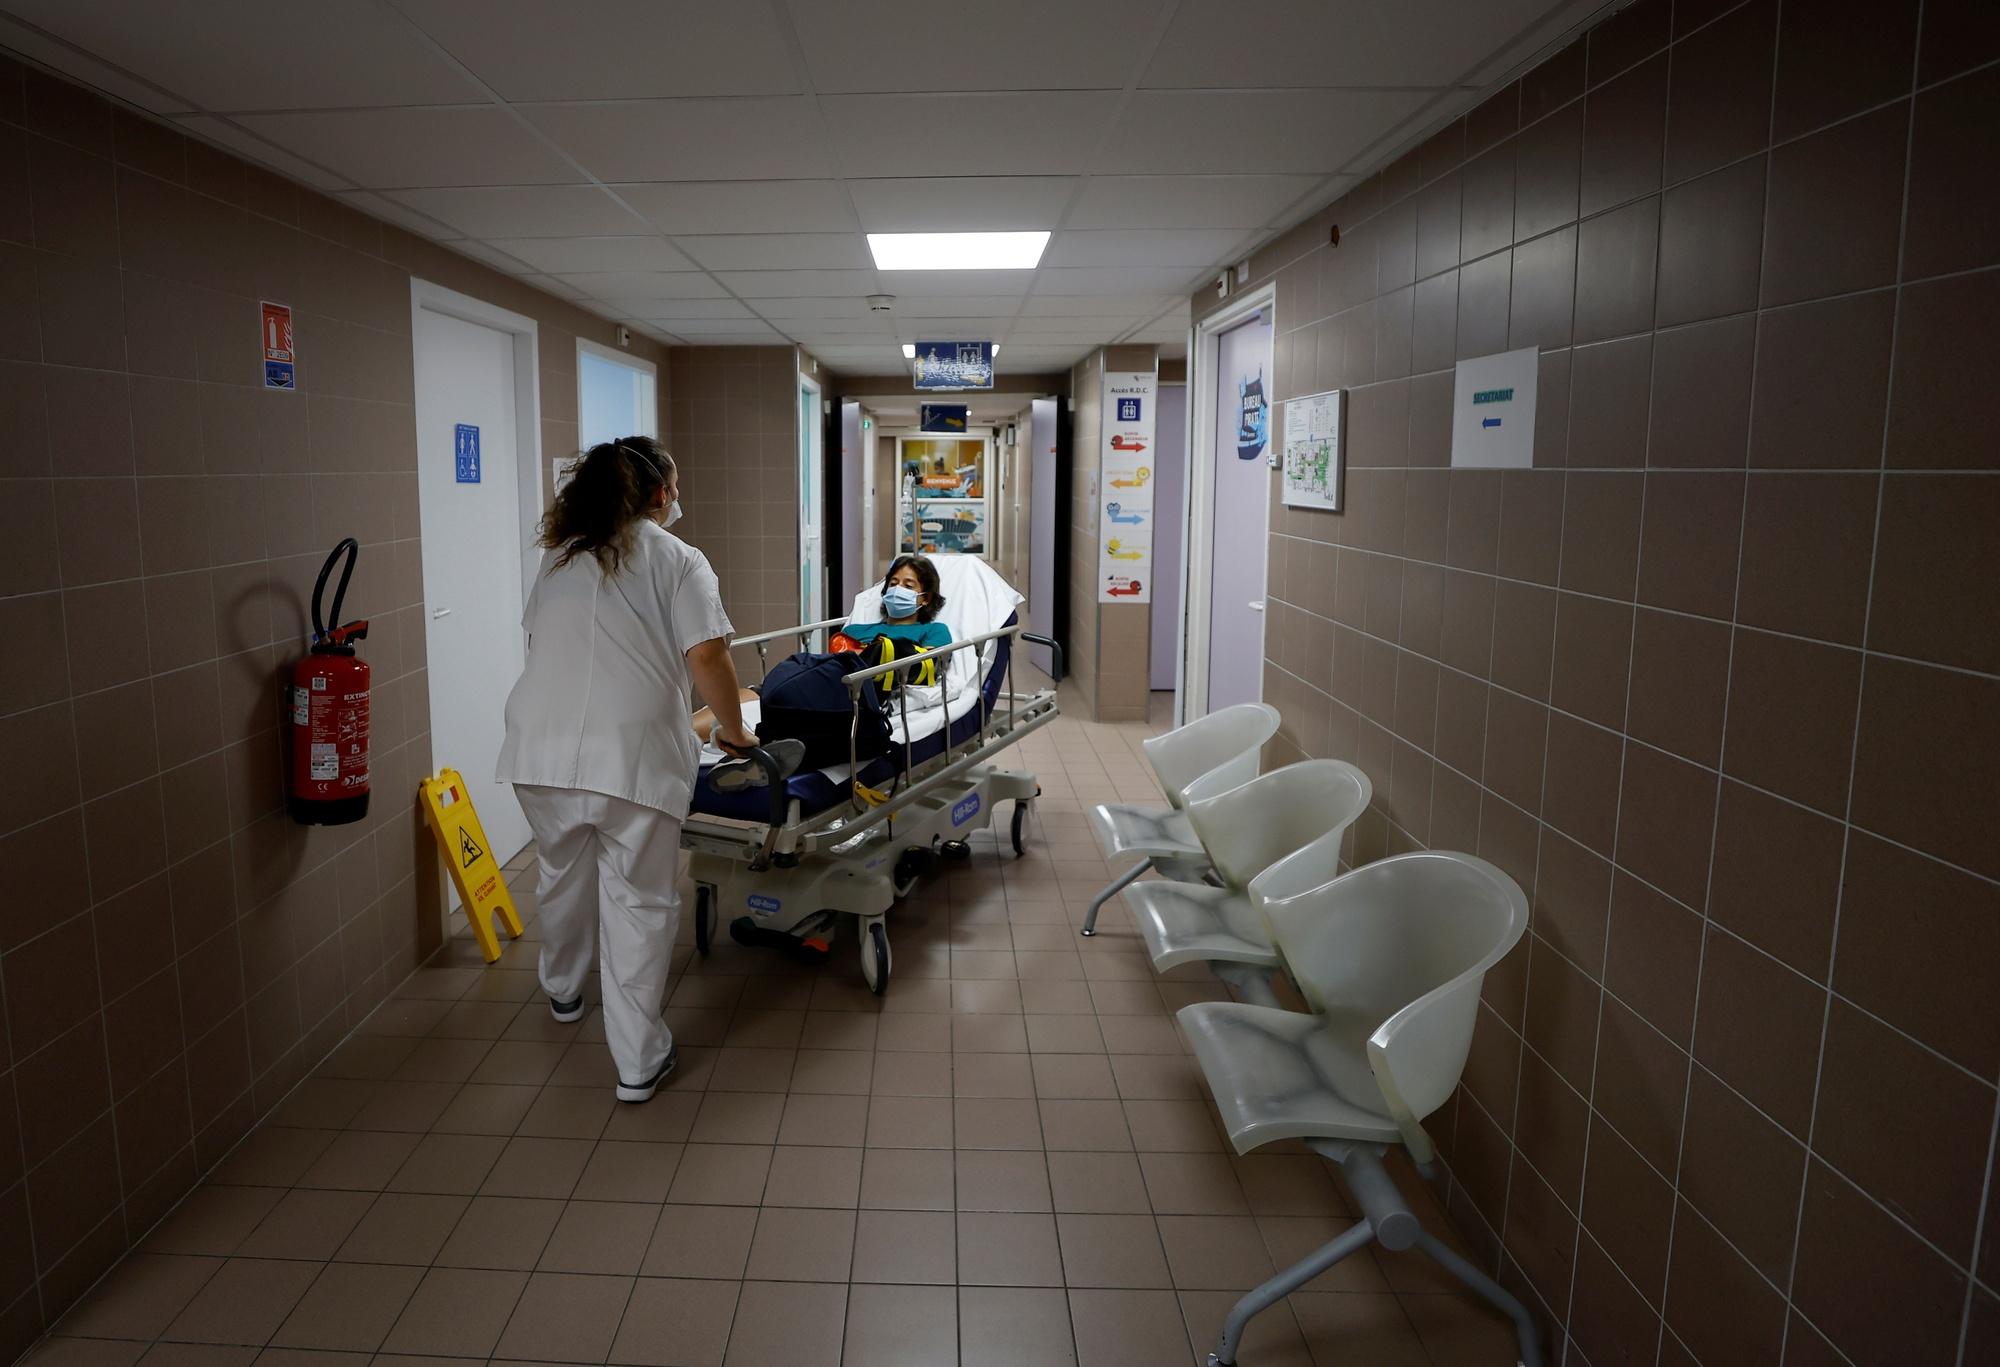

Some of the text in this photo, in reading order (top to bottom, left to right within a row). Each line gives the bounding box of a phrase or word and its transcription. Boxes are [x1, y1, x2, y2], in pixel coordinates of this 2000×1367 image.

[1110, 386, 1129, 394] Accès
[1473, 388, 1514, 405] SECRETARIAT
[1244, 393, 1261, 410] BUREAU
[953, 799, 978, 823] Hill-Rom
[475, 876, 495, 896] ATTENTION
[749, 897, 778, 911] Hill-Rom
